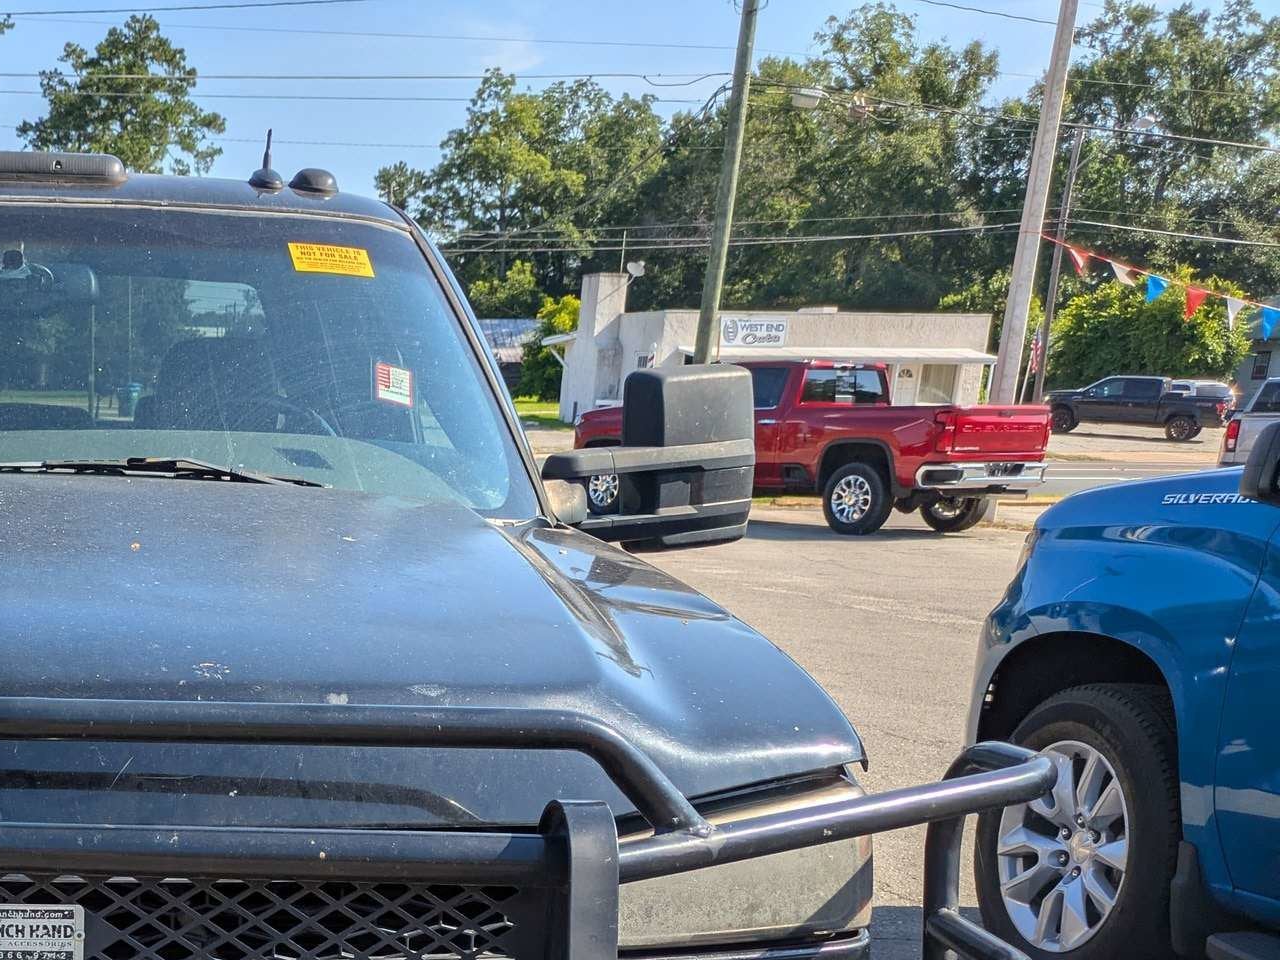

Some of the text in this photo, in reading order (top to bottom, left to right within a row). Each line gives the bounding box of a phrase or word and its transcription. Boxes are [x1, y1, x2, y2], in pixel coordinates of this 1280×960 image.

[740, 323, 785, 332] WEST END
[962, 424, 1041, 433] CHEVROLET
[1161, 493, 1259, 505] SILVERAD
[29, 924, 75, 939] HAND
